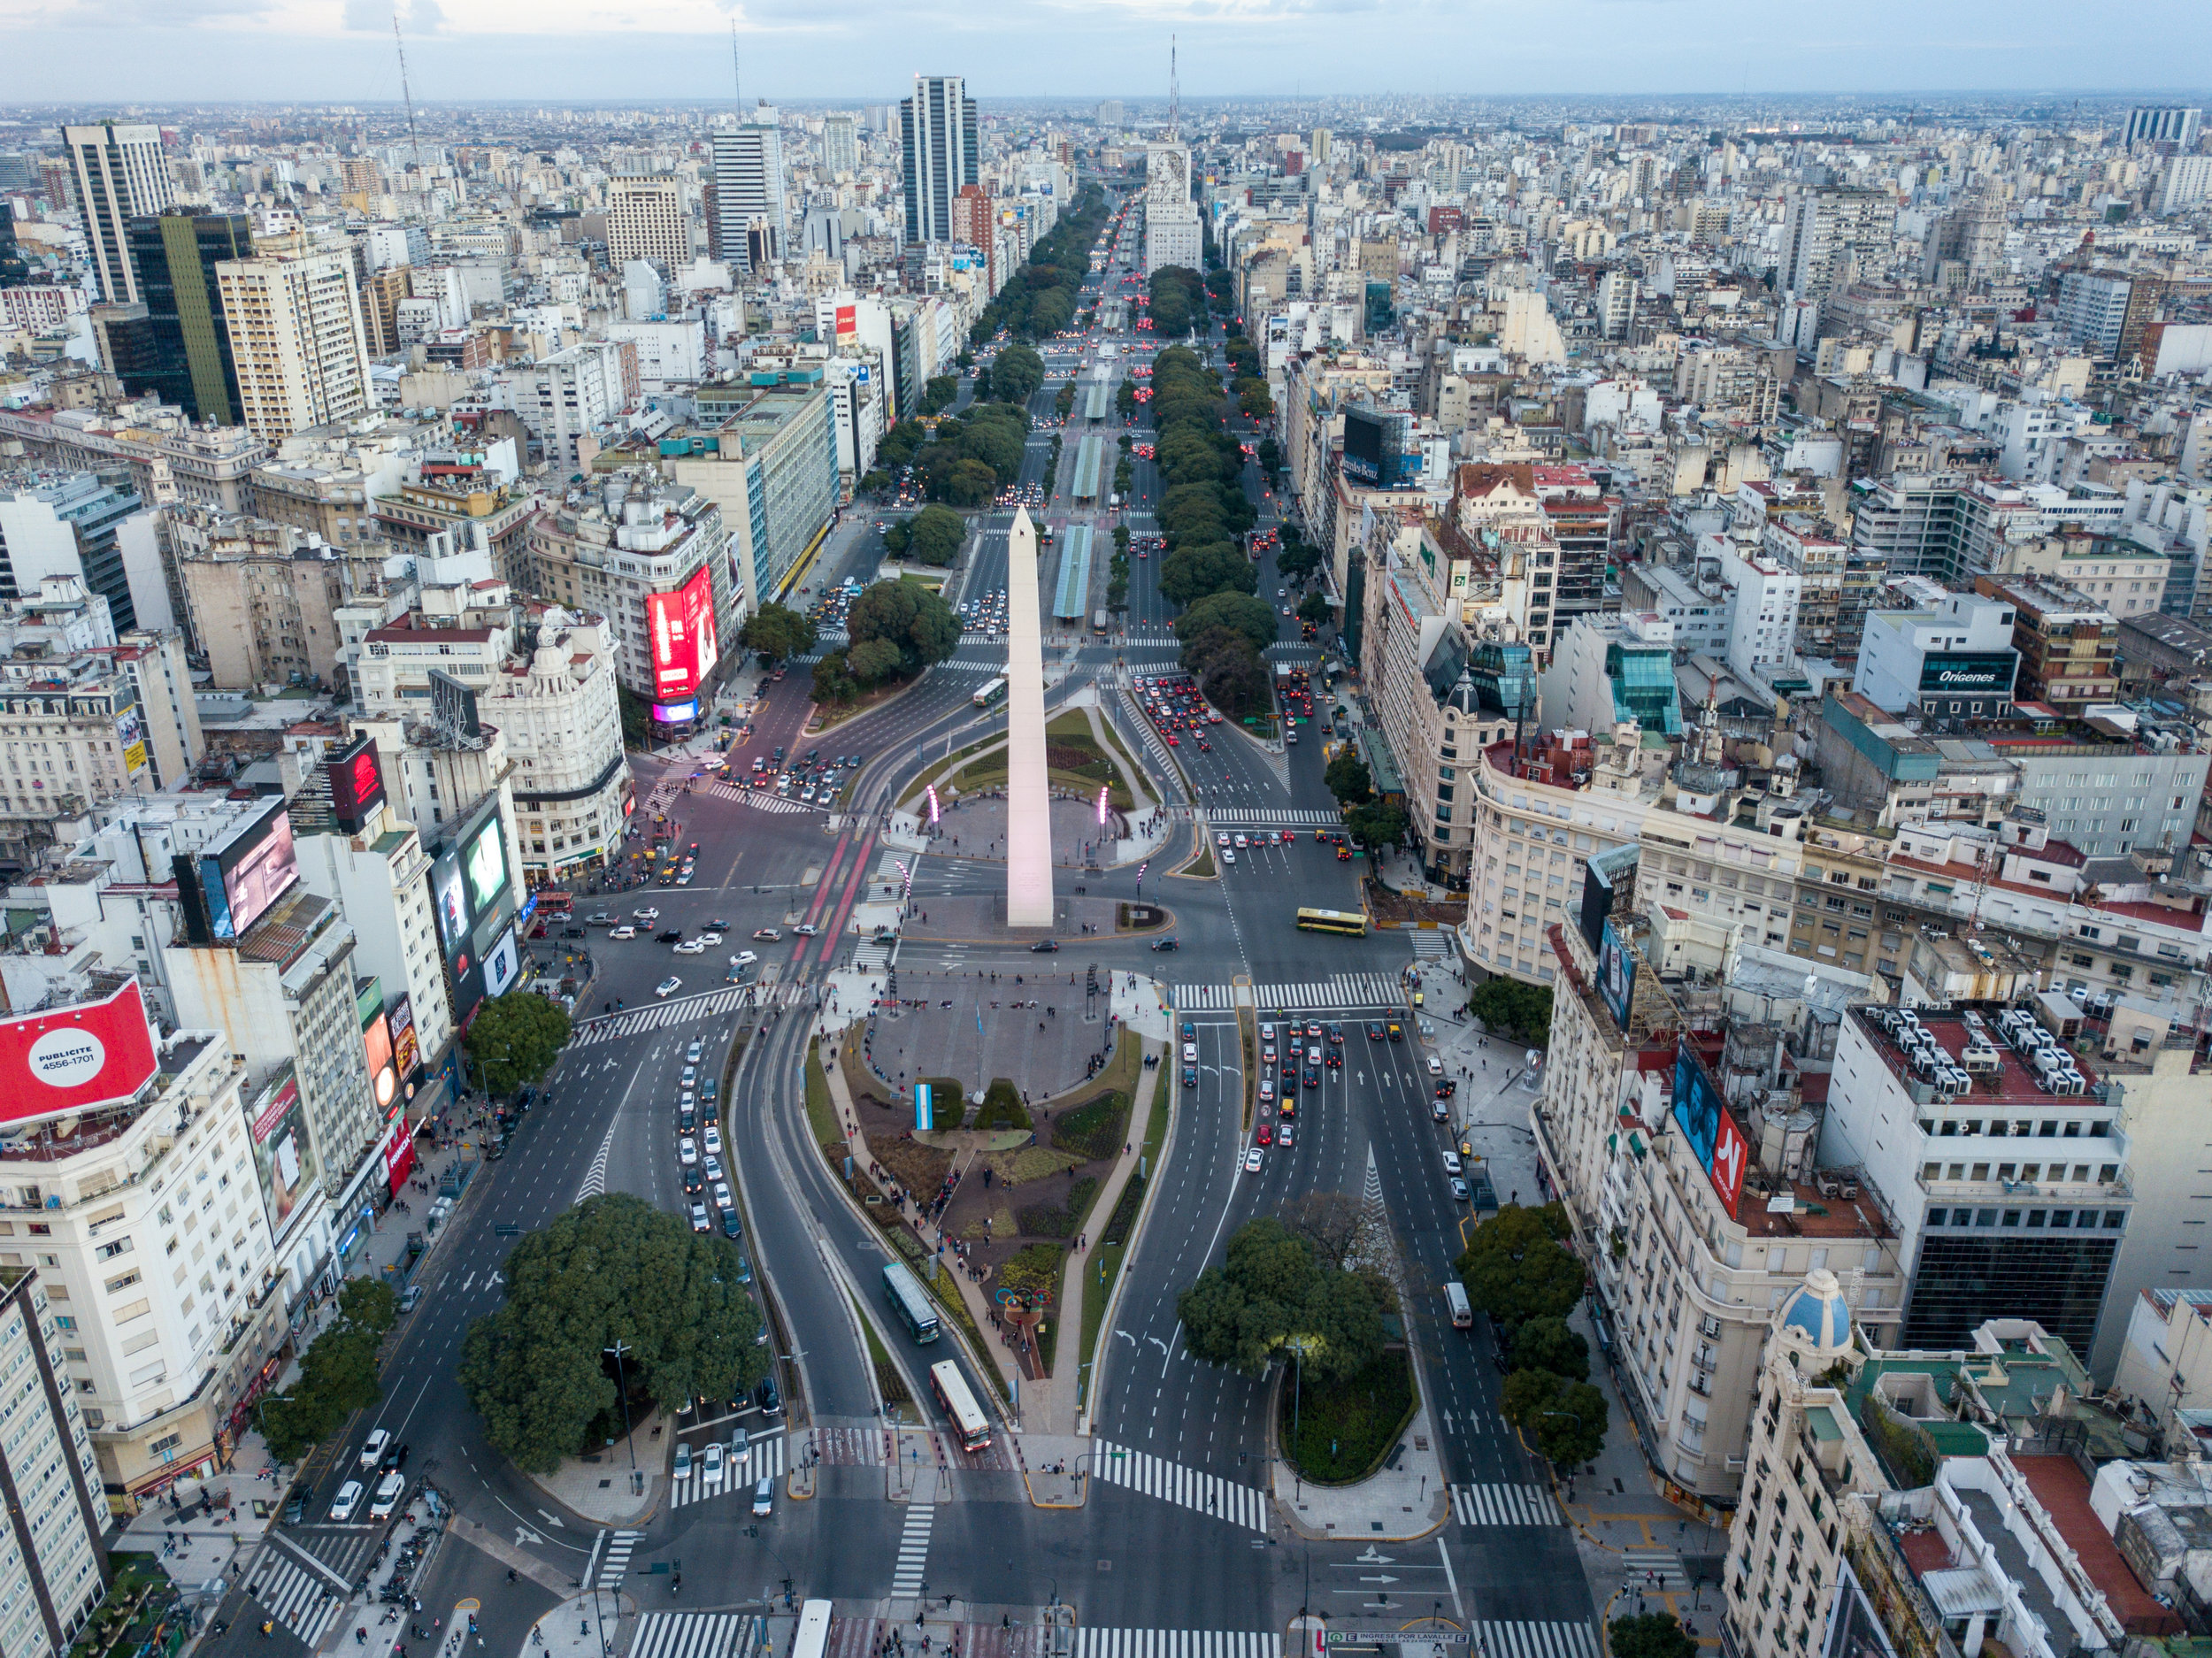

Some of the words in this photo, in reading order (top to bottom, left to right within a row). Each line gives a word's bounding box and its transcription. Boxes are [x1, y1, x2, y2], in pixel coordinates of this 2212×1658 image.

[39, 1046, 92, 1062] PUBLICITE
[42, 1054, 94, 1071] 4556-1701
[1715, 1166, 1732, 1203] Naranja
